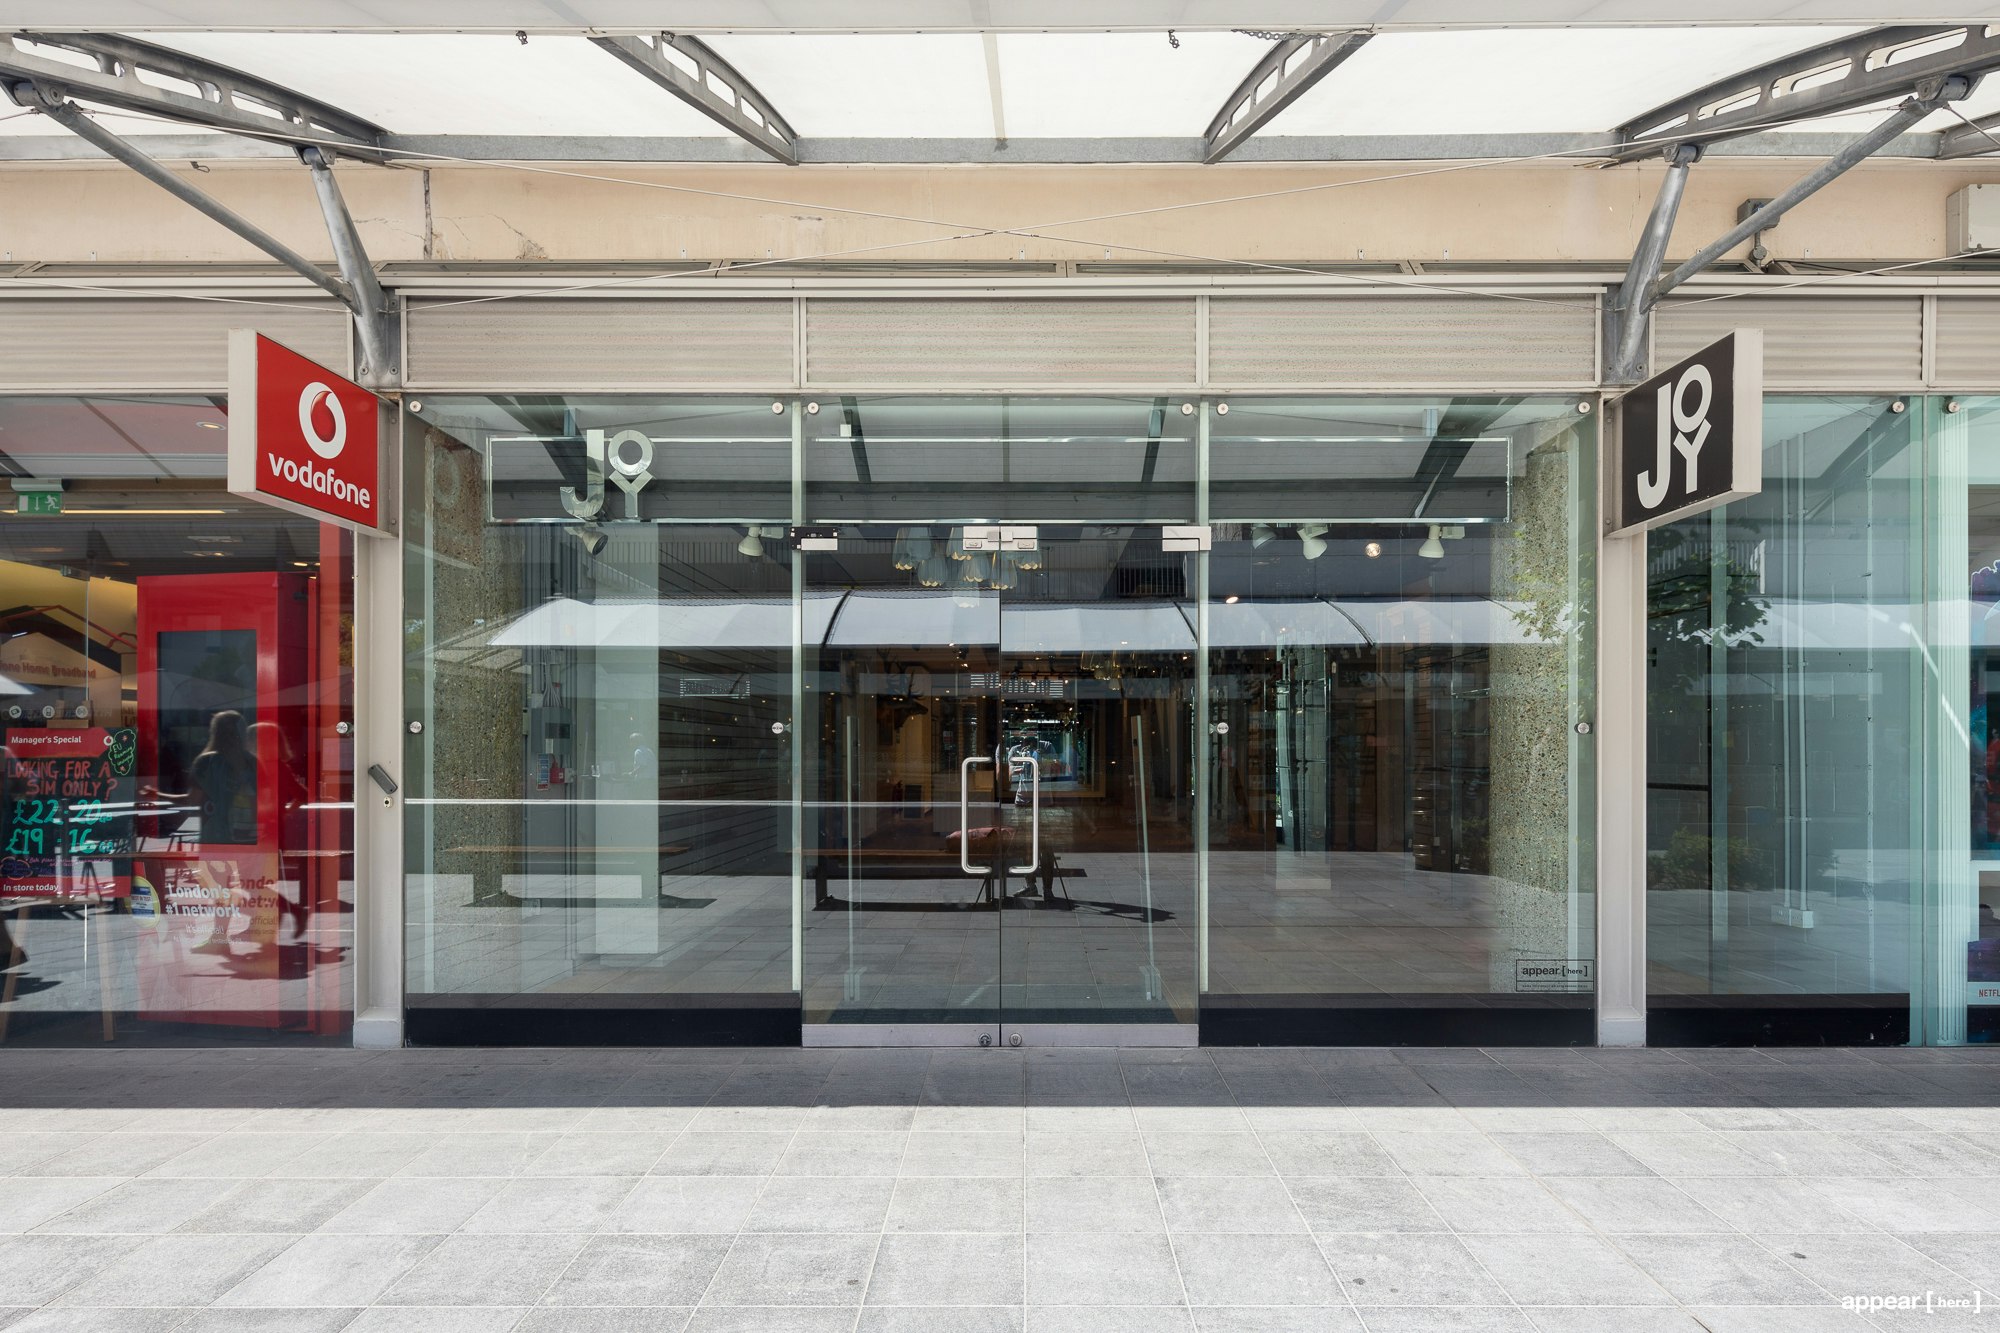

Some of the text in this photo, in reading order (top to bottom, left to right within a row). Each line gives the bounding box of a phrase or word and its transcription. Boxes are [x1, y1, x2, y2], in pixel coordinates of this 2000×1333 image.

[1637, 364, 1713, 509] JOY
[268, 452, 371, 509] vodafone
[560, 429, 653, 521] JOY
[11, 735, 82, 745] Manager's Special
[65, 761, 91, 779] FOR
[98, 761, 111, 778] A
[35, 884, 59, 892] today
[167, 883, 231, 899] London's
[165, 903, 180, 916] #1
[182, 903, 242, 918] network
[1522, 966, 1560, 977] appear
